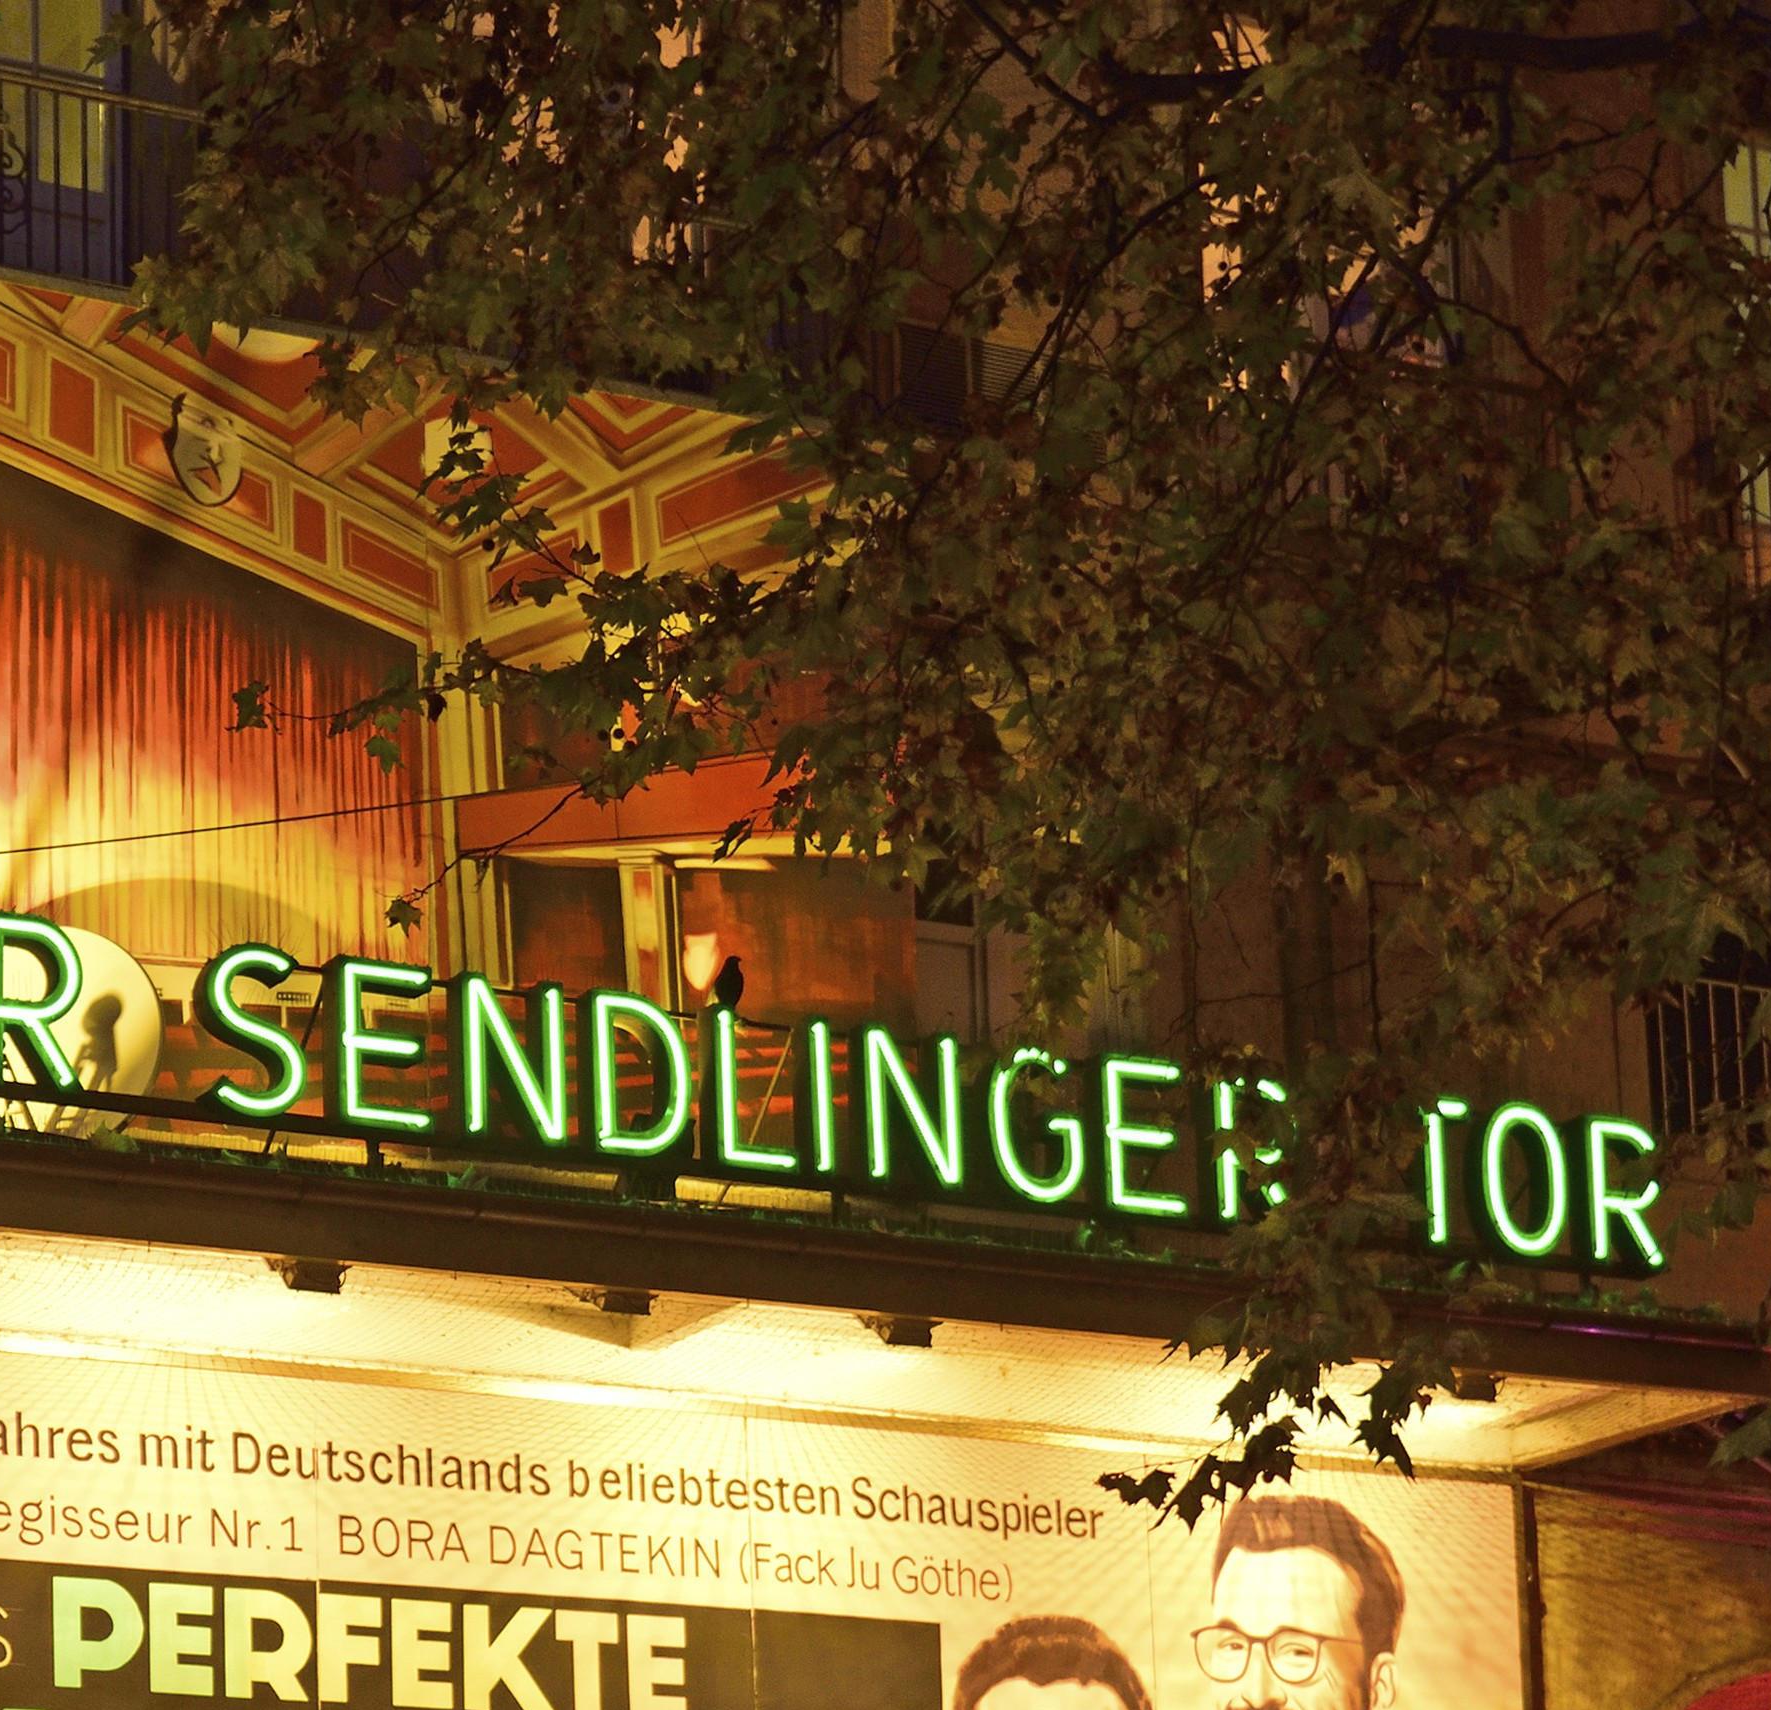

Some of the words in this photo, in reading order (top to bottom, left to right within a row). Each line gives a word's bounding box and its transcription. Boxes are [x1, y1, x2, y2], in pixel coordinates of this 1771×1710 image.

[204, 940, 1290, 1224] SENDLINGER
[1423, 1096, 1666, 1272] TOR
[137, 1423, 216, 1474] mit
[233, 1429, 550, 1498] Deutschlands
[567, 1457, 842, 1521] beliebtesten
[852, 1475, 1105, 1543] Schauspieler
[336, 1513, 470, 1564] BORA
[488, 1524, 722, 1581] DAGTEKIN
[739, 1539, 840, 1592] (Fack
[893, 1551, 1015, 1604] Göthe)
